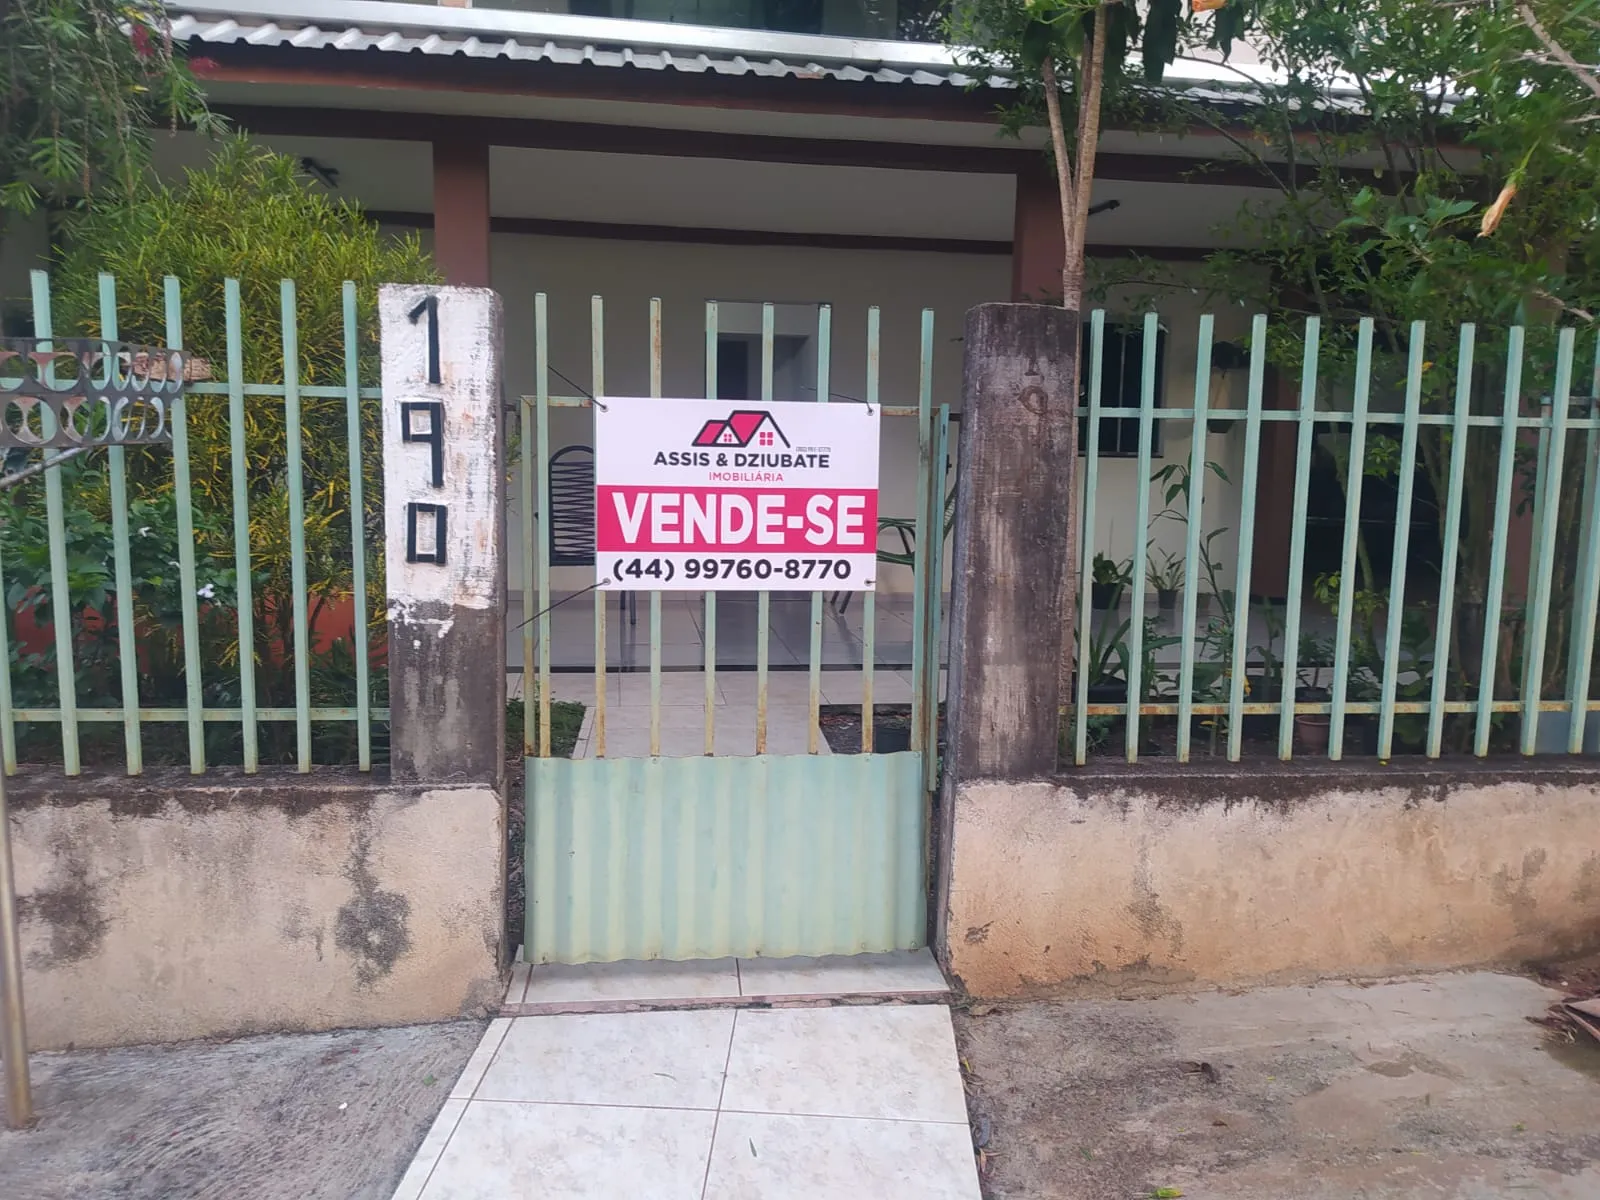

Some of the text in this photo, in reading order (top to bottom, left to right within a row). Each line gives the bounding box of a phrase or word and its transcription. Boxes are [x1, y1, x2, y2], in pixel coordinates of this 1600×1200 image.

[654, 451, 831, 469] ASSIS & DZIUBATE
[709, 471, 784, 482] IMOBILIÁRIA
[612, 492, 866, 546] VENDE-SE
[613, 559, 852, 582] (44) 99760-8770
